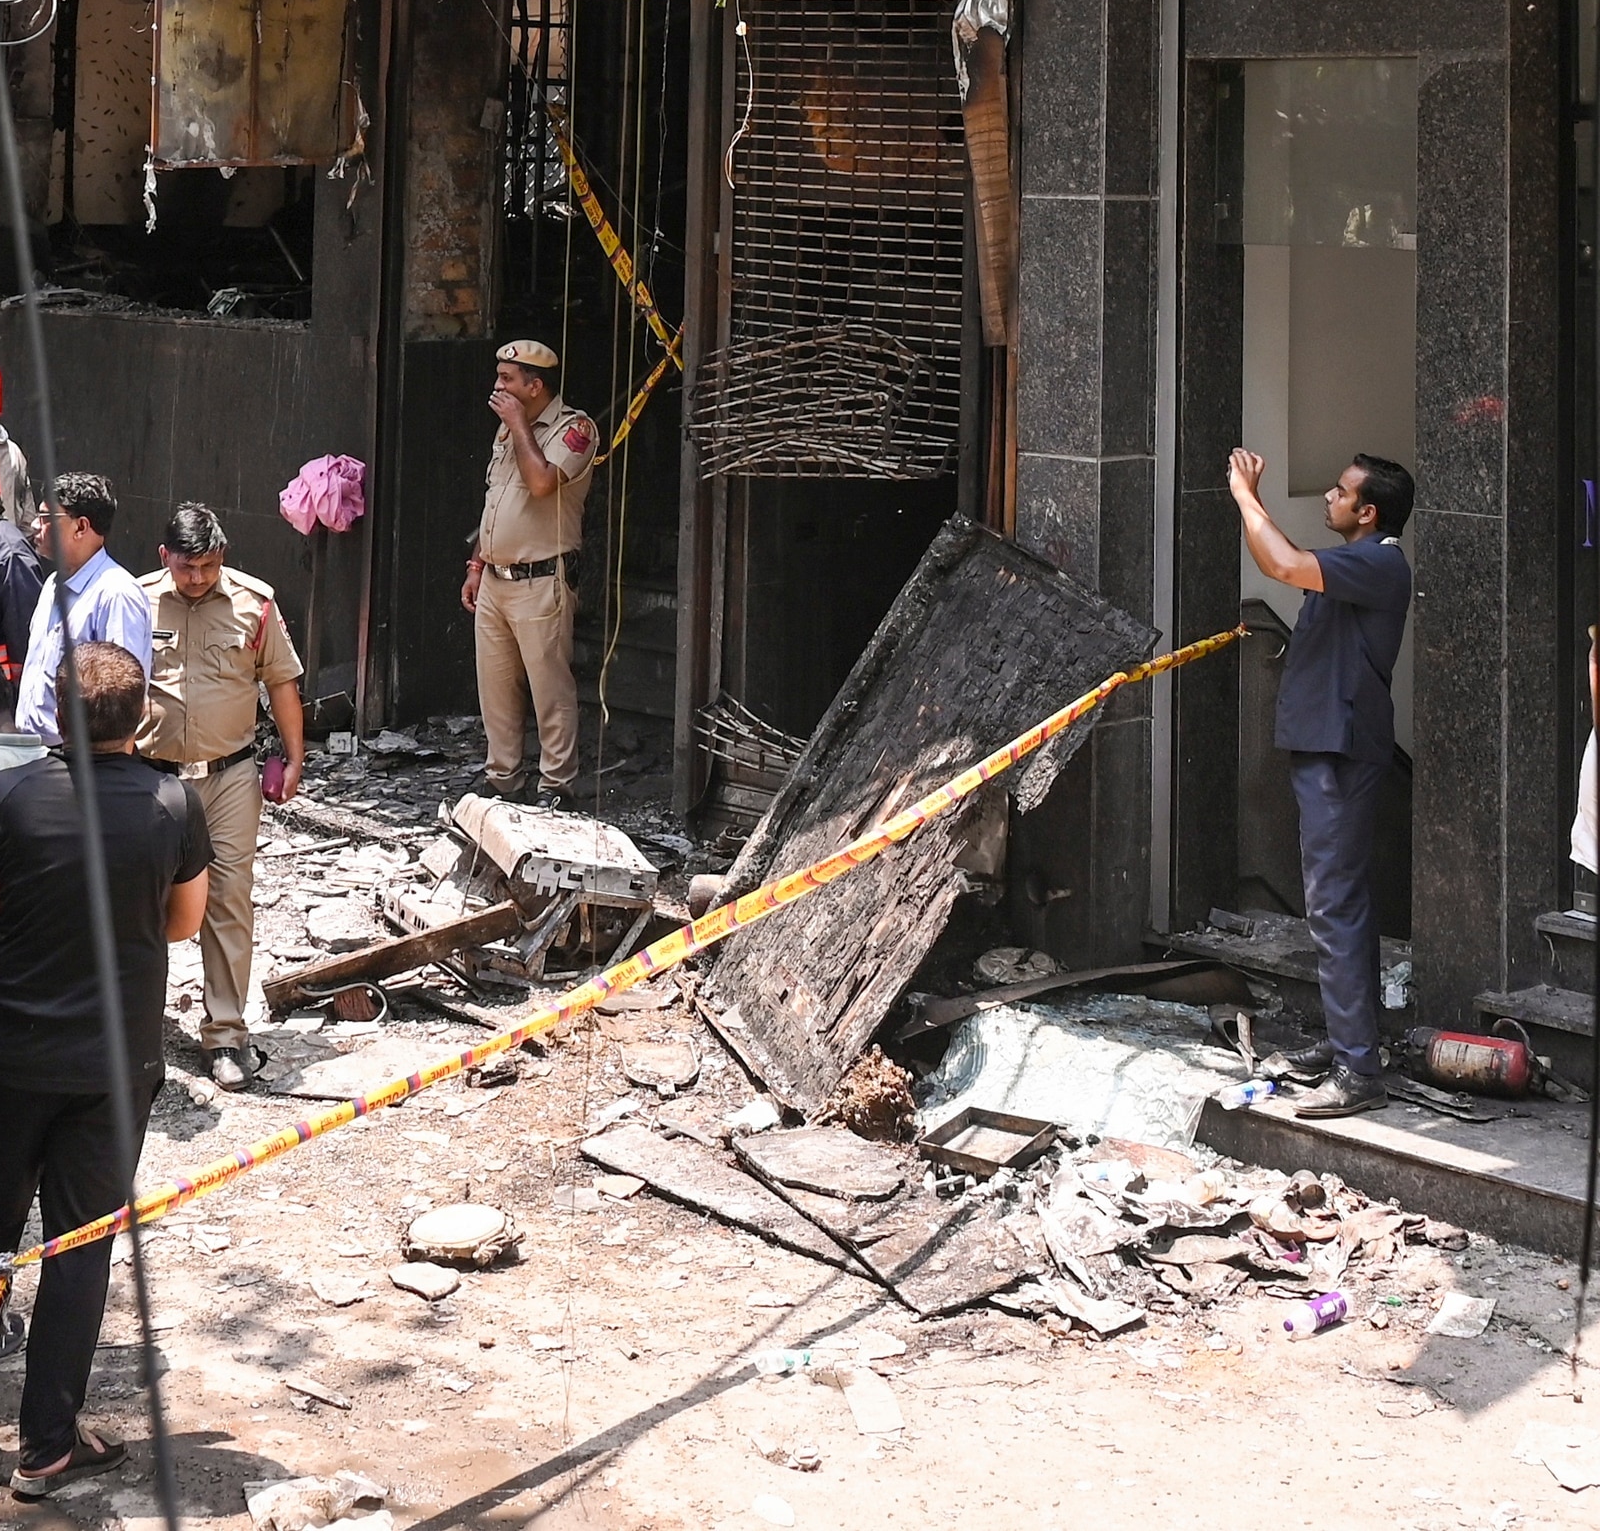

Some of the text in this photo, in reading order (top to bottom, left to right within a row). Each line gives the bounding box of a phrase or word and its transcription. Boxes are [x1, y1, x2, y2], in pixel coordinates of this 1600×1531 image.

[695, 913, 722, 935] DO NOT
[610, 966, 638, 987] DELHI
[430, 1065, 451, 1080] LINE
[265, 1136, 288, 1156] LINE
